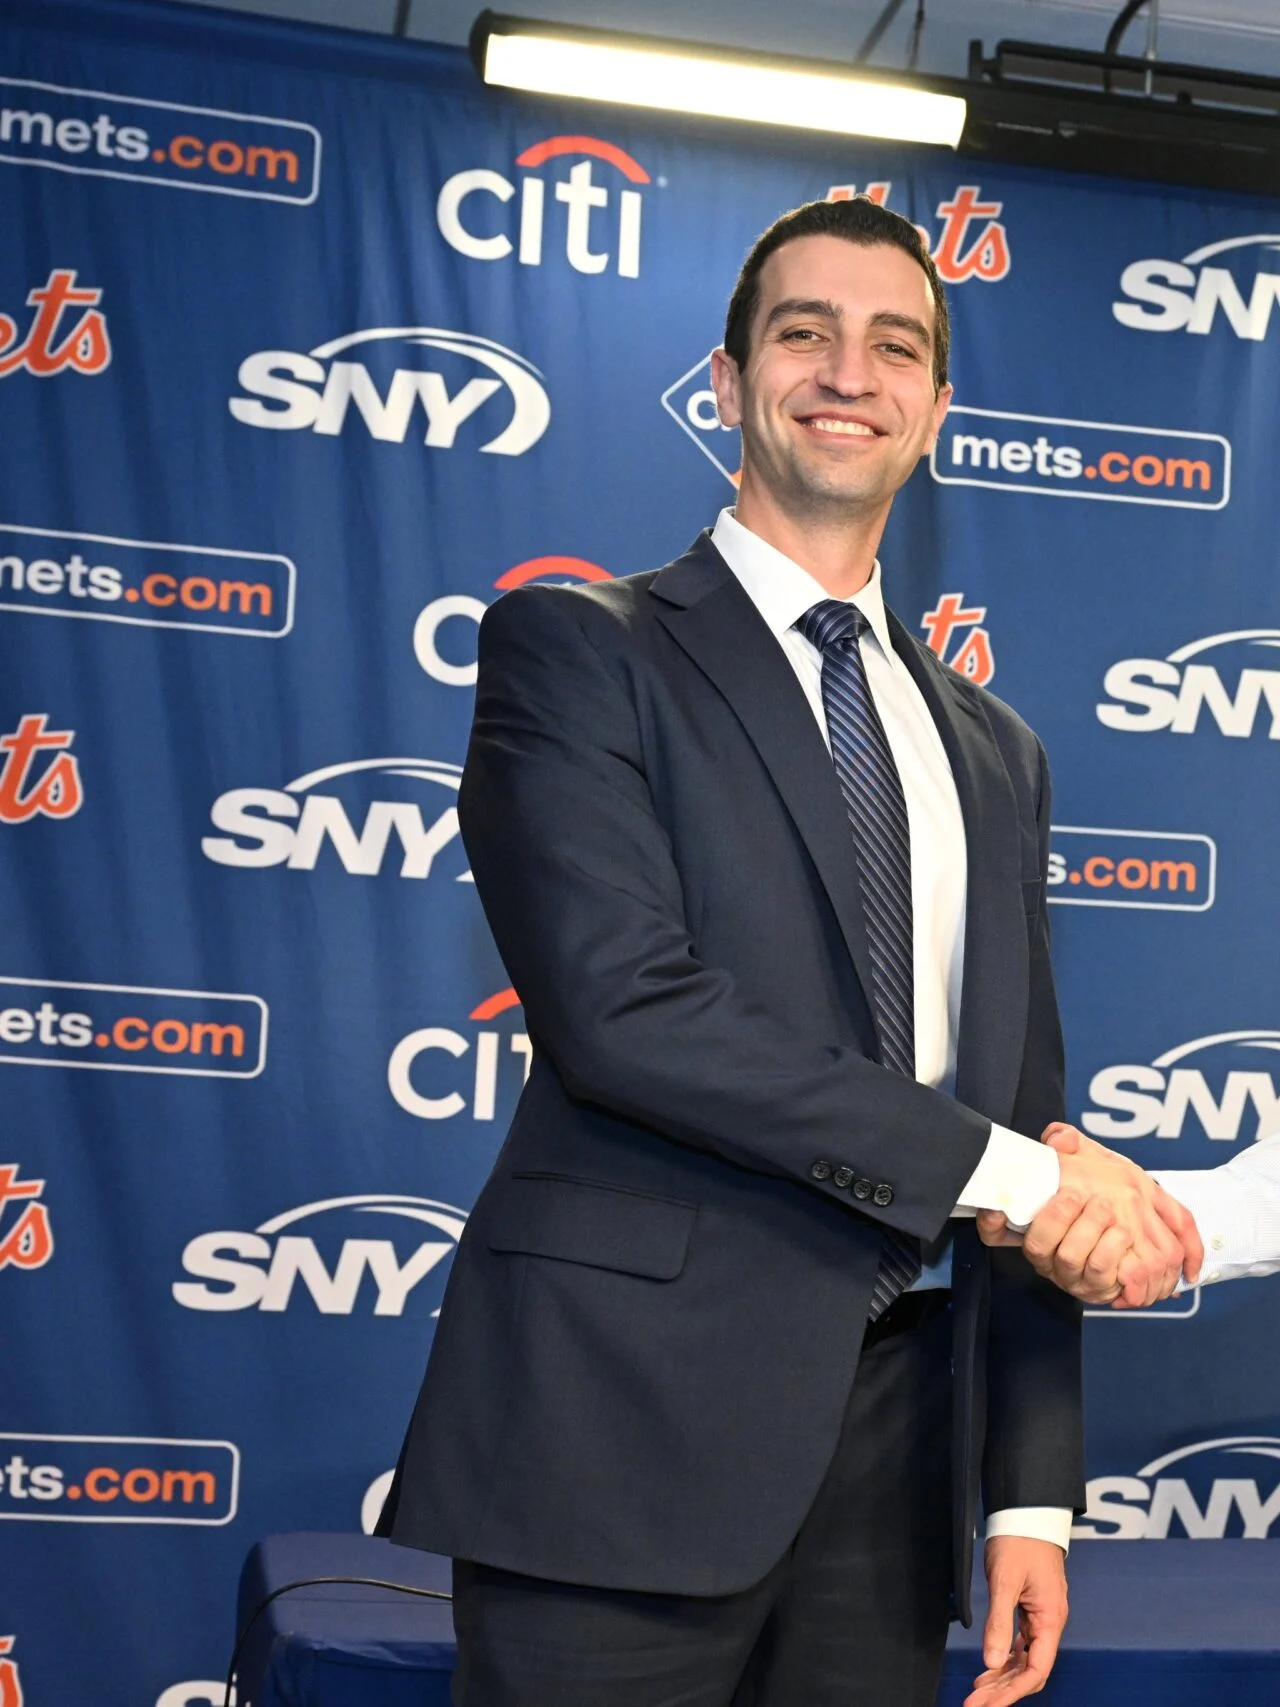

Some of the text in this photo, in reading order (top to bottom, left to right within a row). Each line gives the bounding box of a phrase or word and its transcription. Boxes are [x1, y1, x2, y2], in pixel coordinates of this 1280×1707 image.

[1, 107, 300, 183] mets.com
[437, 161, 642, 279] citi
[228, 350, 502, 449] SNY
[951, 434, 1210, 490] mets.com
[202, 788, 458, 879] SNY
[1046, 851, 1196, 892] s.com
[0, 1003, 244, 1056] ets.com
[172, 1231, 455, 1316] SNY
[0, 1456, 216, 1503] ts.com
